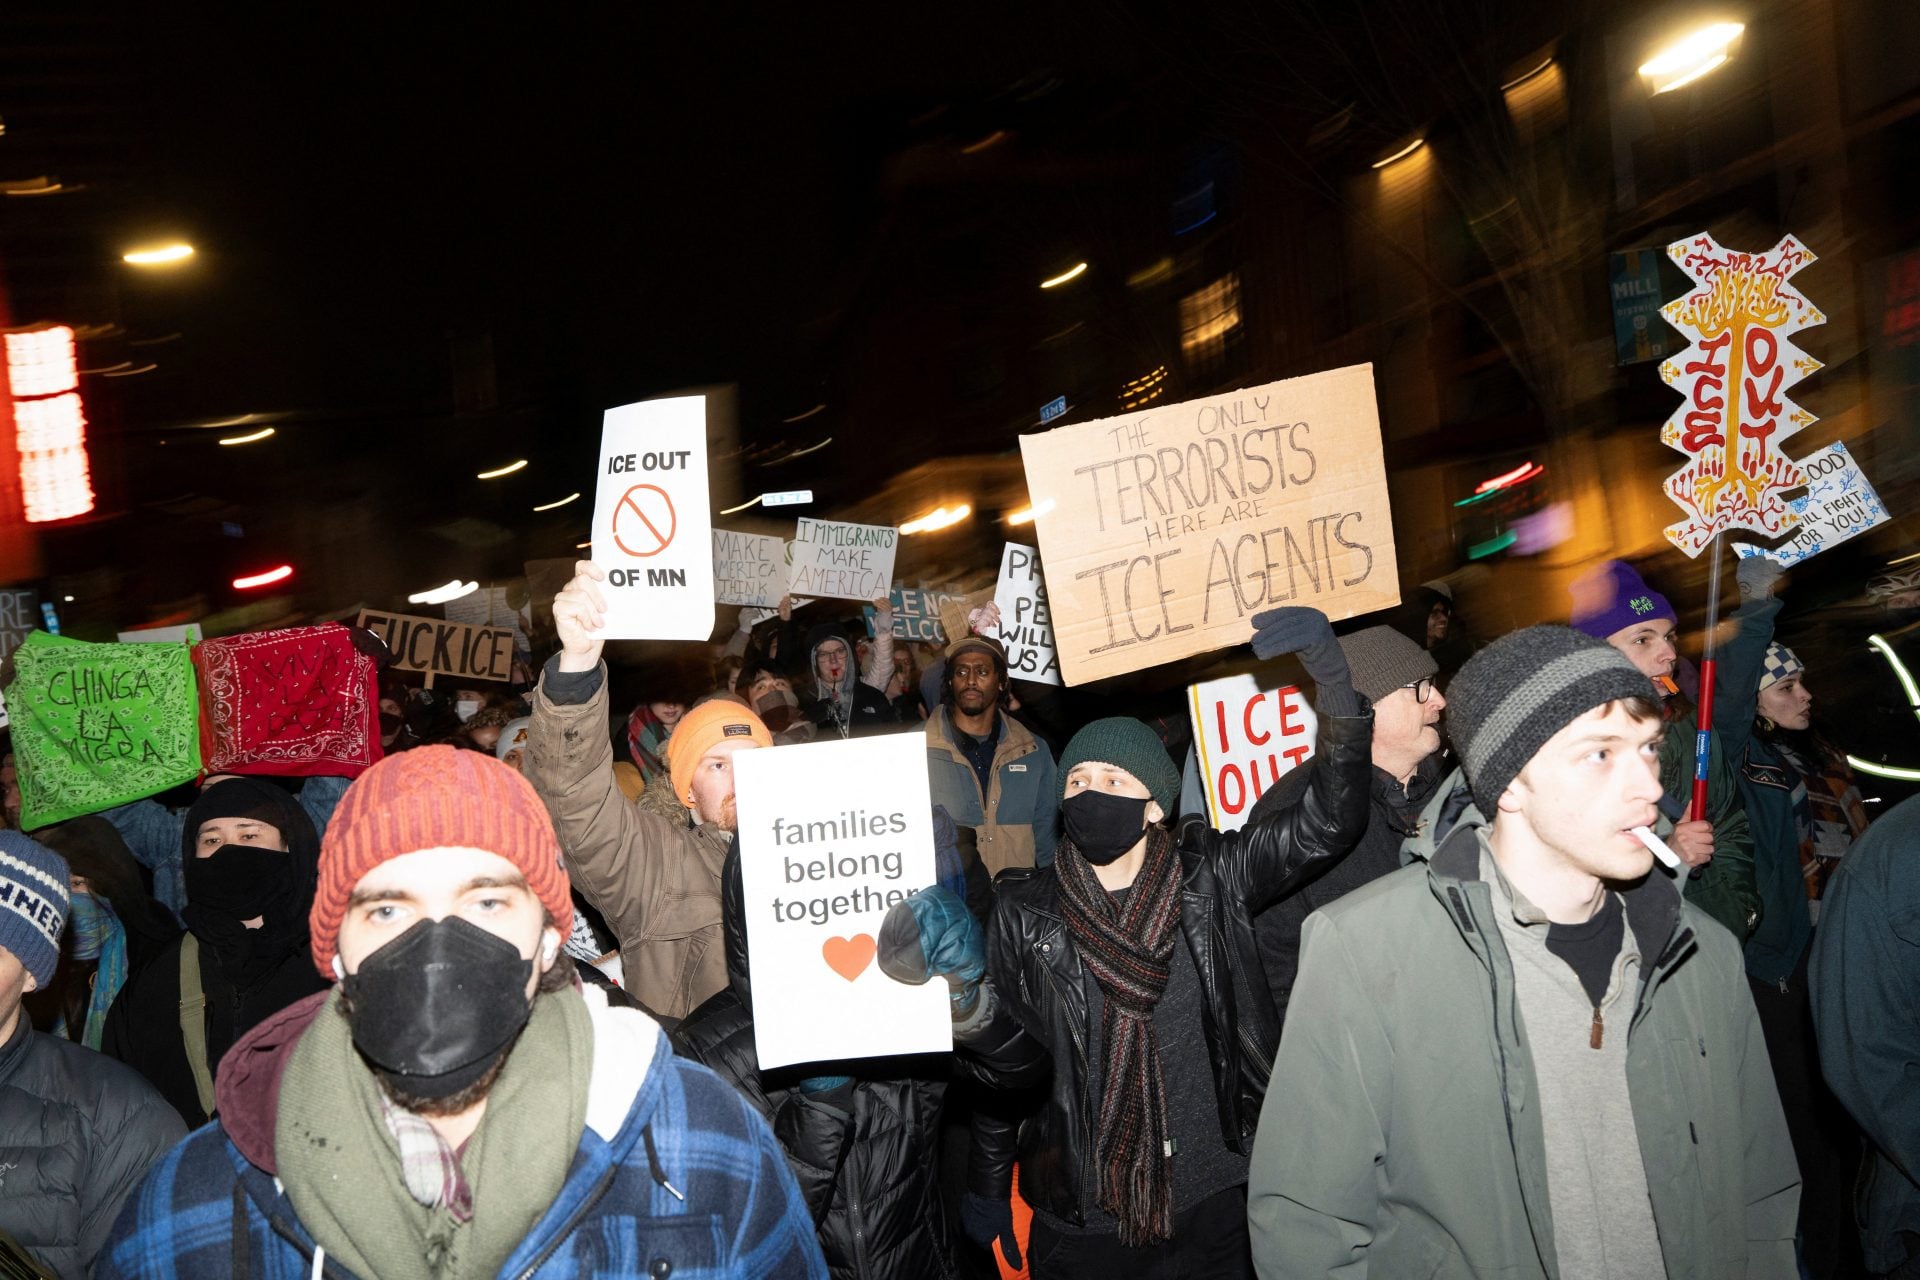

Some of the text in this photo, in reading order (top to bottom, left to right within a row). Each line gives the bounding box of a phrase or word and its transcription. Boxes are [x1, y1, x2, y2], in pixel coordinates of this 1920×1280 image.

[1613, 278, 1658, 299] MILL
[1682, 331, 1731, 453] ICE
[1740, 327, 1784, 467] OUT
[1108, 396, 1270, 452] THE ONLY
[607, 450, 691, 475] ICE OUT
[1074, 422, 1316, 532] TERRORISTS
[1802, 453, 1847, 483] OOD
[1823, 490, 1863, 516] FIGHT
[797, 520, 895, 548] IMMIGRANTS
[1144, 498, 1268, 547] HERE ARE
[1790, 506, 1868, 551] FOR YOU!
[713, 531, 770, 562] MAKE
[816, 548, 872, 571] MAKE
[608, 568, 687, 587] OF MN
[718, 579, 768, 595] THINK
[791, 565, 887, 598] AMERICA
[1075, 511, 1373, 654] ICE AGENTS
[718, 592, 767, 605] AGAIN
[999, 621, 1052, 648] WILL
[459, 627, 513, 679] ICE
[48, 668, 155, 708] CHINGA
[80, 709, 133, 743] LA
[1215, 685, 1306, 753] ICE
[772, 810, 907, 846] families
[784, 851, 903, 884] belong
